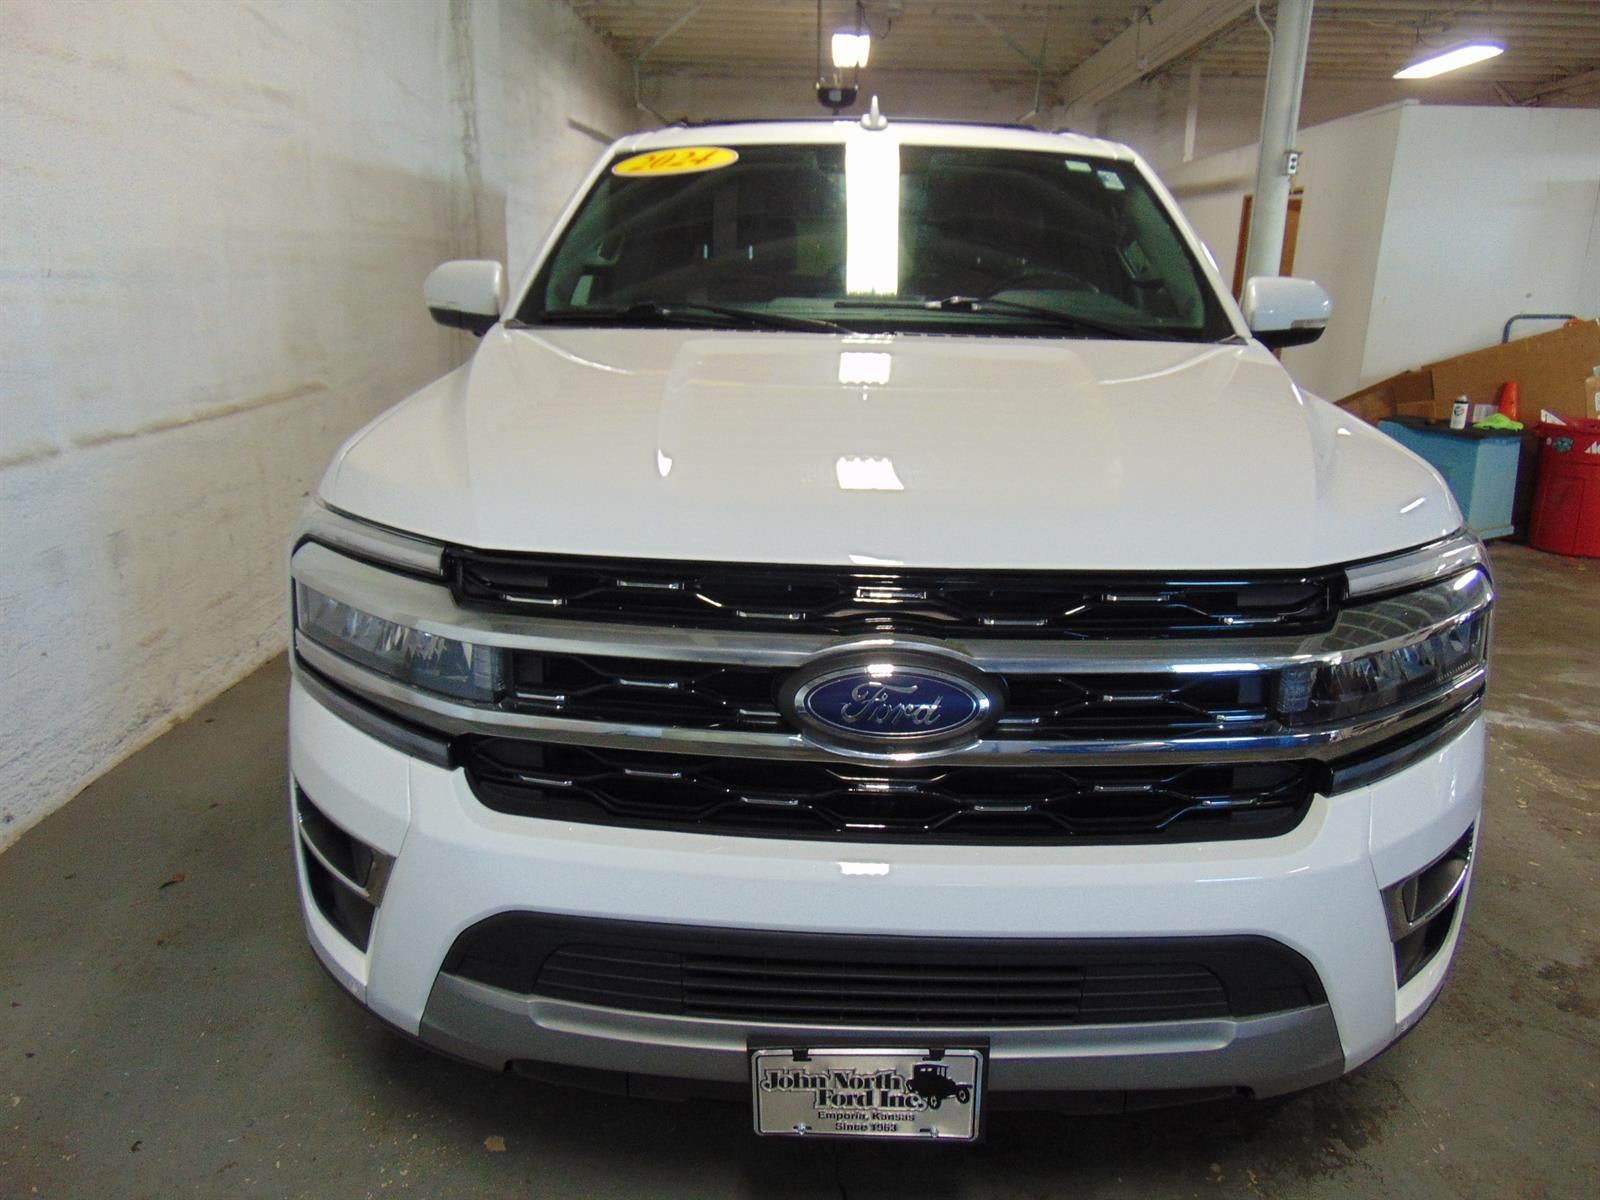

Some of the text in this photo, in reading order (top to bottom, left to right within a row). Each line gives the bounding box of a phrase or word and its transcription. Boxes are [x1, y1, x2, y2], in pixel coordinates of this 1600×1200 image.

[628, 149, 720, 172] 2024
[840, 681, 943, 725] Ford
[761, 1070, 903, 1091] John North
[815, 1089, 873, 1108] Ford
[817, 1111, 915, 1121] Emporia, Kansas
[835, 1122, 897, 1132] Since 1963
